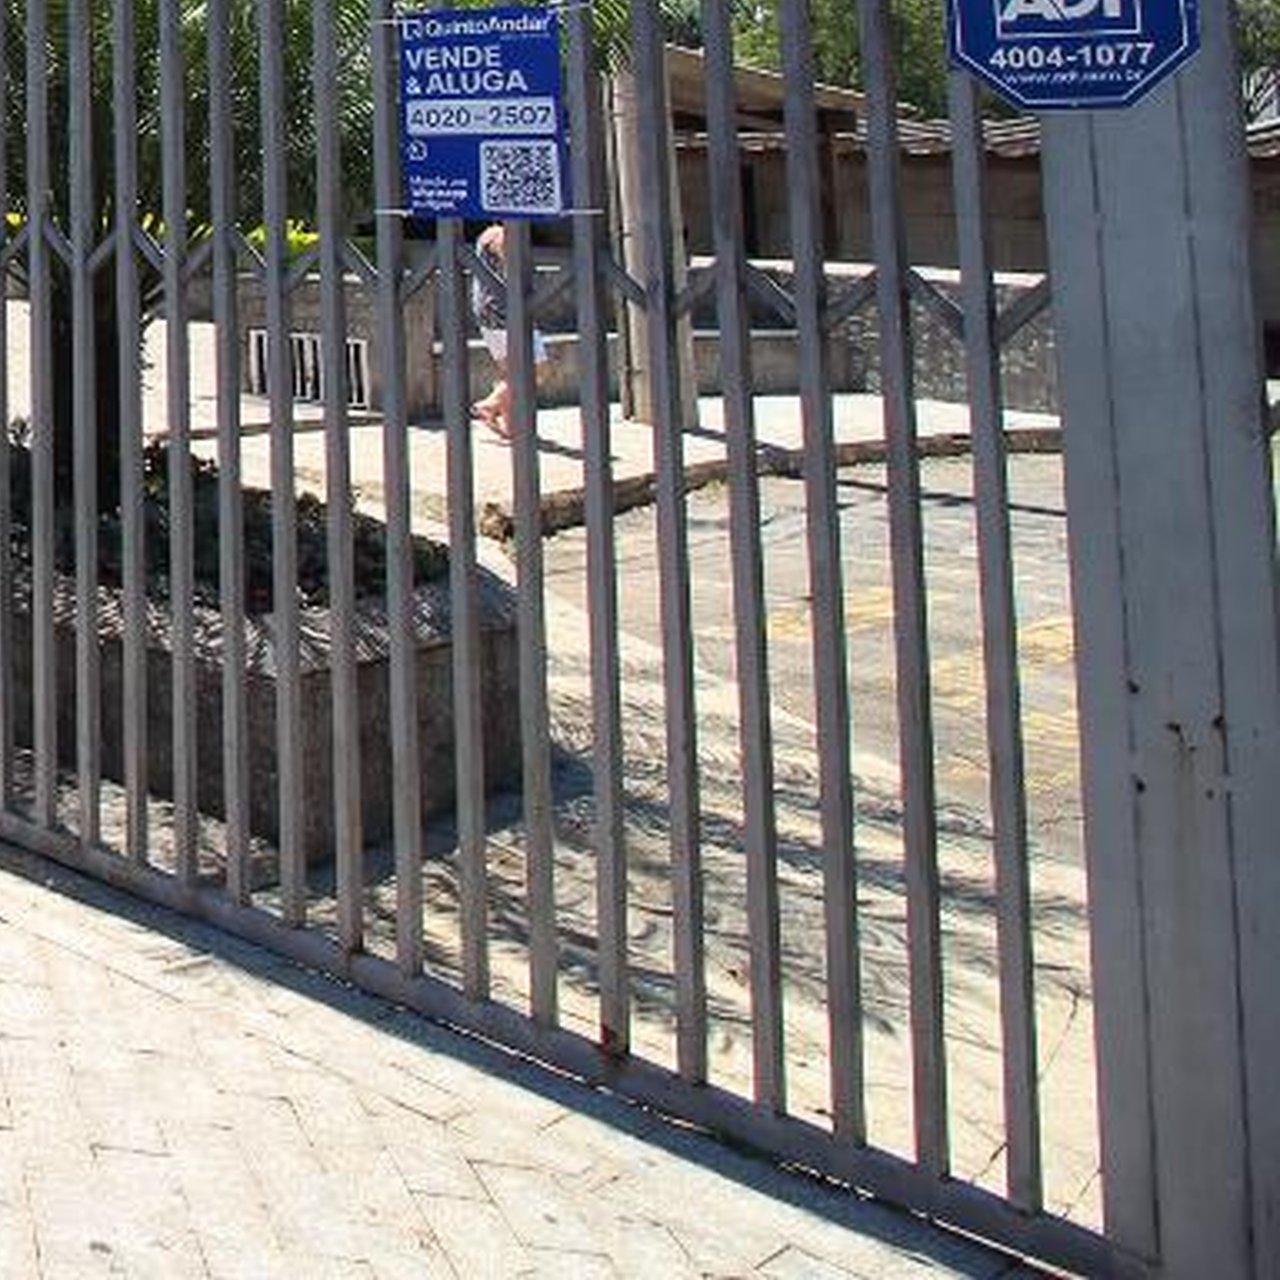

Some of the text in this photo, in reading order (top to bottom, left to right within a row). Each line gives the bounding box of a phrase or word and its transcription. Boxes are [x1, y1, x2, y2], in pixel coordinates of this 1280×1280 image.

[405, 46, 502, 70] VENDE
[989, 43, 1155, 69] 4004-1077
[405, 70, 529, 95] & ALUGA
[410, 106, 552, 129] 4020-2507
